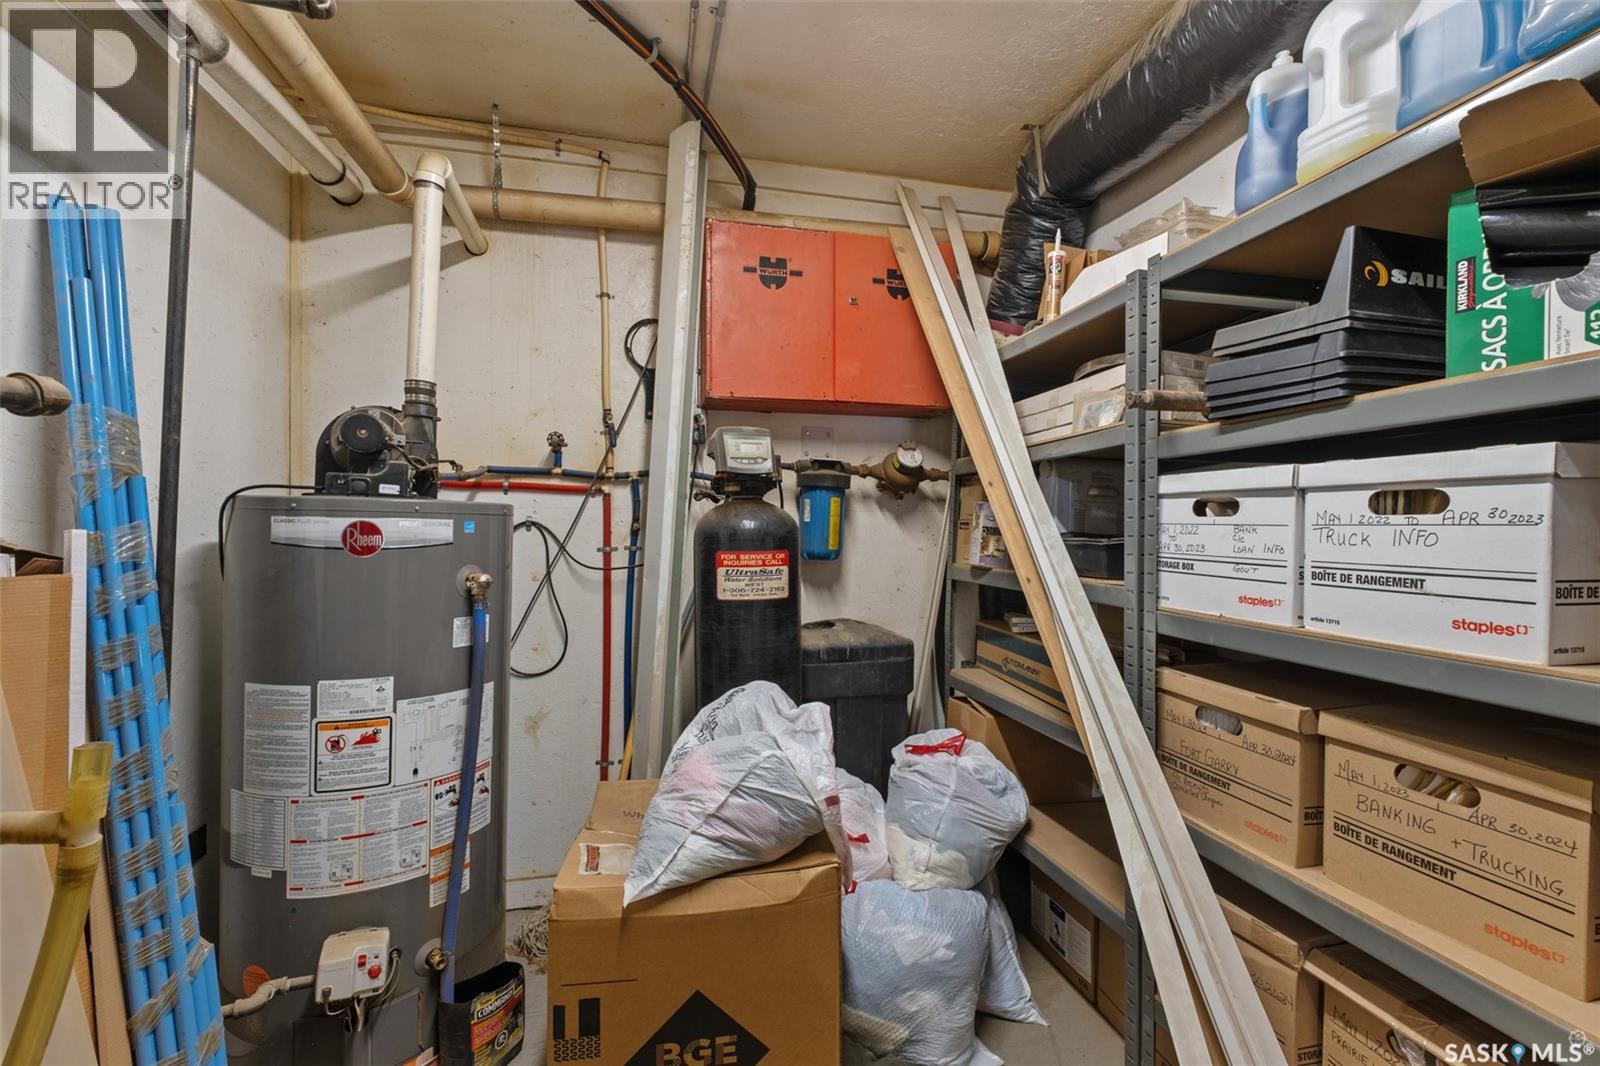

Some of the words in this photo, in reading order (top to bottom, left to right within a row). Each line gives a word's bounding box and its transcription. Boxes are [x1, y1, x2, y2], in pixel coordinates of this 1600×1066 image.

[1457, 260, 1469, 312] KIRKLAND
[1481, 315, 1507, 372] SACS
[1233, 525, 1258, 534] BANK
[1358, 515, 1392, 525] 2022
[1404, 516, 1419, 525] TO
[1442, 509, 1480, 525] APR
[1488, 507, 1508, 520] 30
[1508, 513, 1544, 525] 2023
[346, 522, 382, 552] Rheem
[1263, 544, 1285, 554] INFO
[1312, 527, 1371, 547] TRUCK
[1393, 527, 1439, 547] INFO
[724, 567, 785, 576] UltraSafe
[1182, 562, 1195, 571] BOX
[1311, 570, 1337, 583] BOÎTE
[1339, 573, 1353, 584] DE
[1355, 574, 1426, 590] RANGEMENT
[1555, 584, 1584, 599] BOÎTE
[1587, 586, 1599, 599] DE
[1452, 618, 1515, 636] staples
[1179, 761, 1188, 772] DE
[1188, 765, 1232, 791] RANGEMENT
[1337, 759, 1364, 788] MAY
[1355, 793, 1436, 835] BANKING
[1467, 806, 1497, 831] APR
[1333, 821, 1362, 843] BOÎTE
[1365, 833, 1379, 850] DE
[1381, 839, 1457, 882] RANGEMENT
[1483, 921, 1552, 962] staples
[478, 989, 513, 1018] COMMAND
[656, 1035, 738, 1066] BGE
